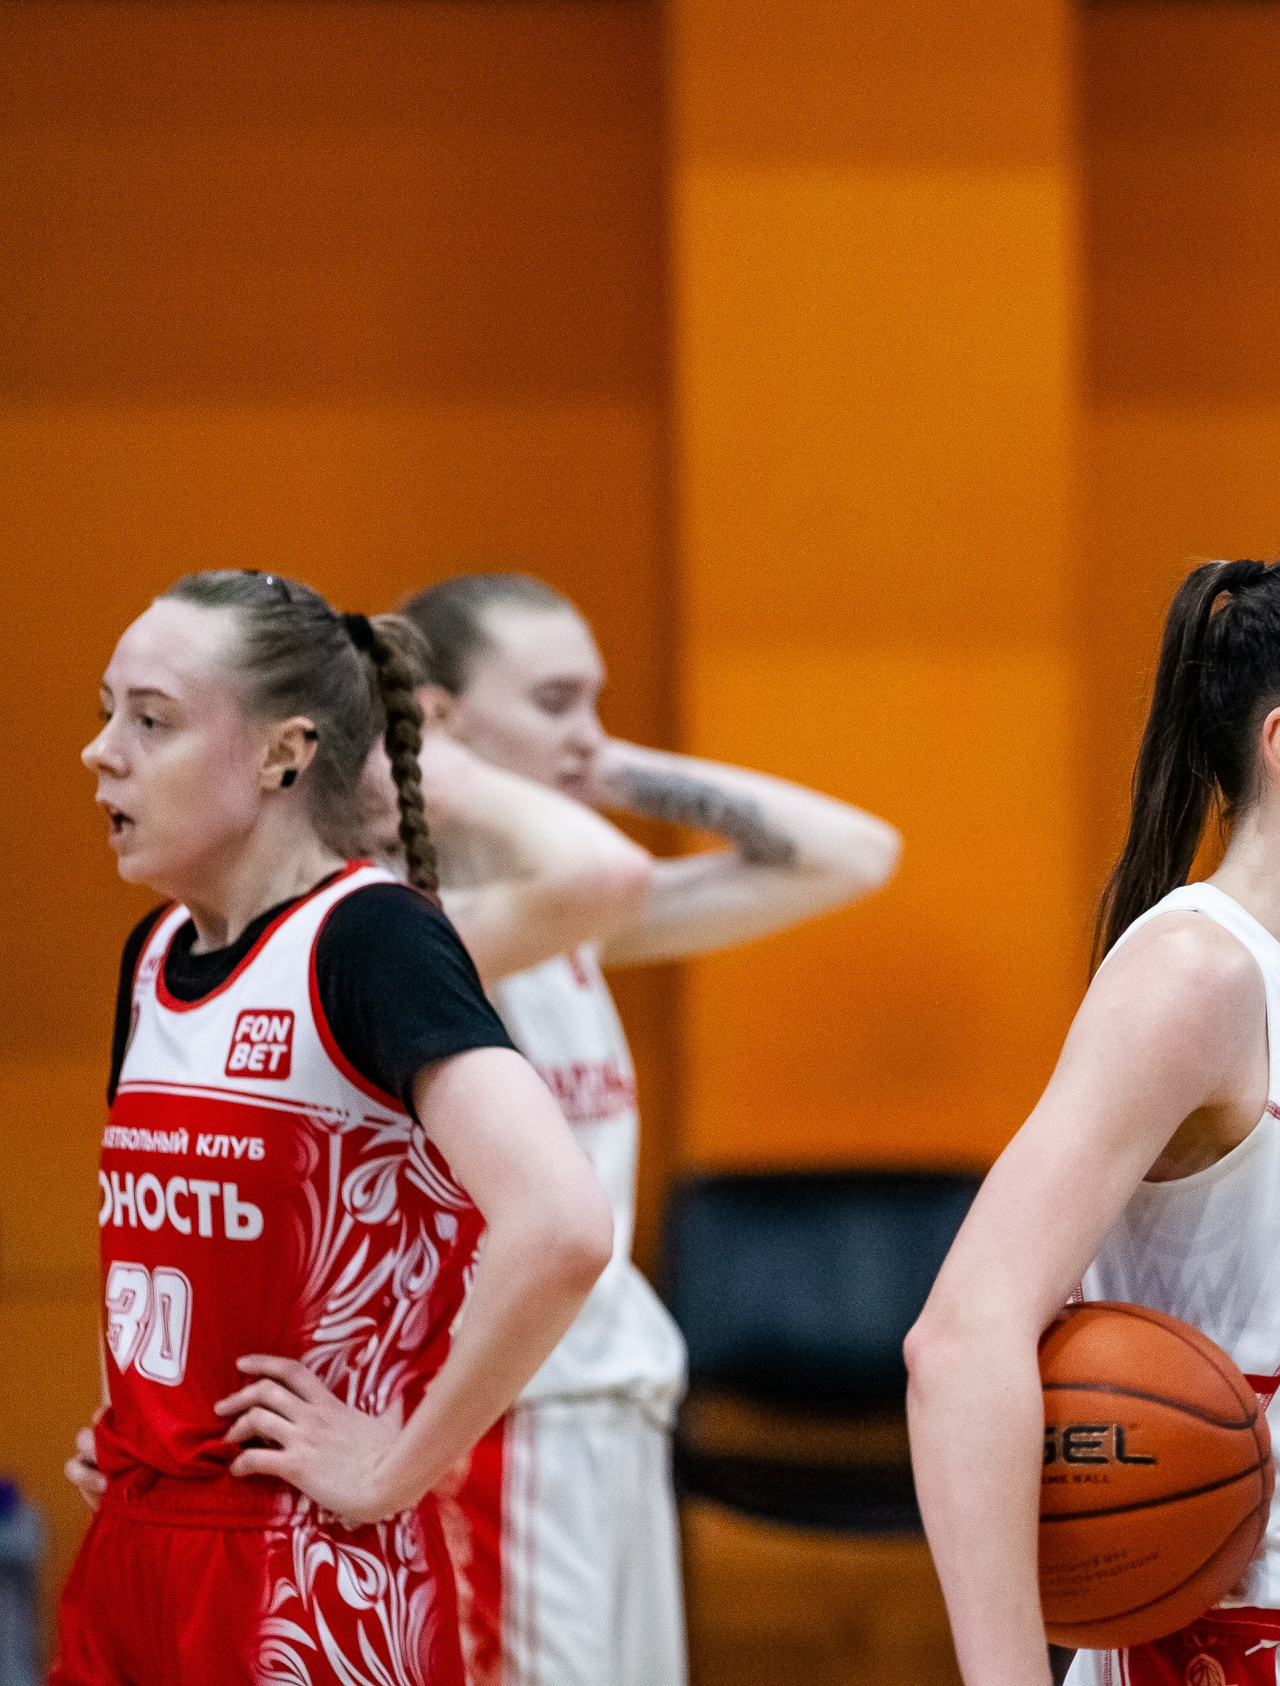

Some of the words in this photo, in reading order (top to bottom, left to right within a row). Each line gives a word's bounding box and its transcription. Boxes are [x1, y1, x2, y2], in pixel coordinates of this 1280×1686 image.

[235, 1014, 291, 1042] FON
[228, 1042, 288, 1072] BET
[196, 1133, 266, 1161] КЛУБ
[105, 1260, 193, 1387] 30
